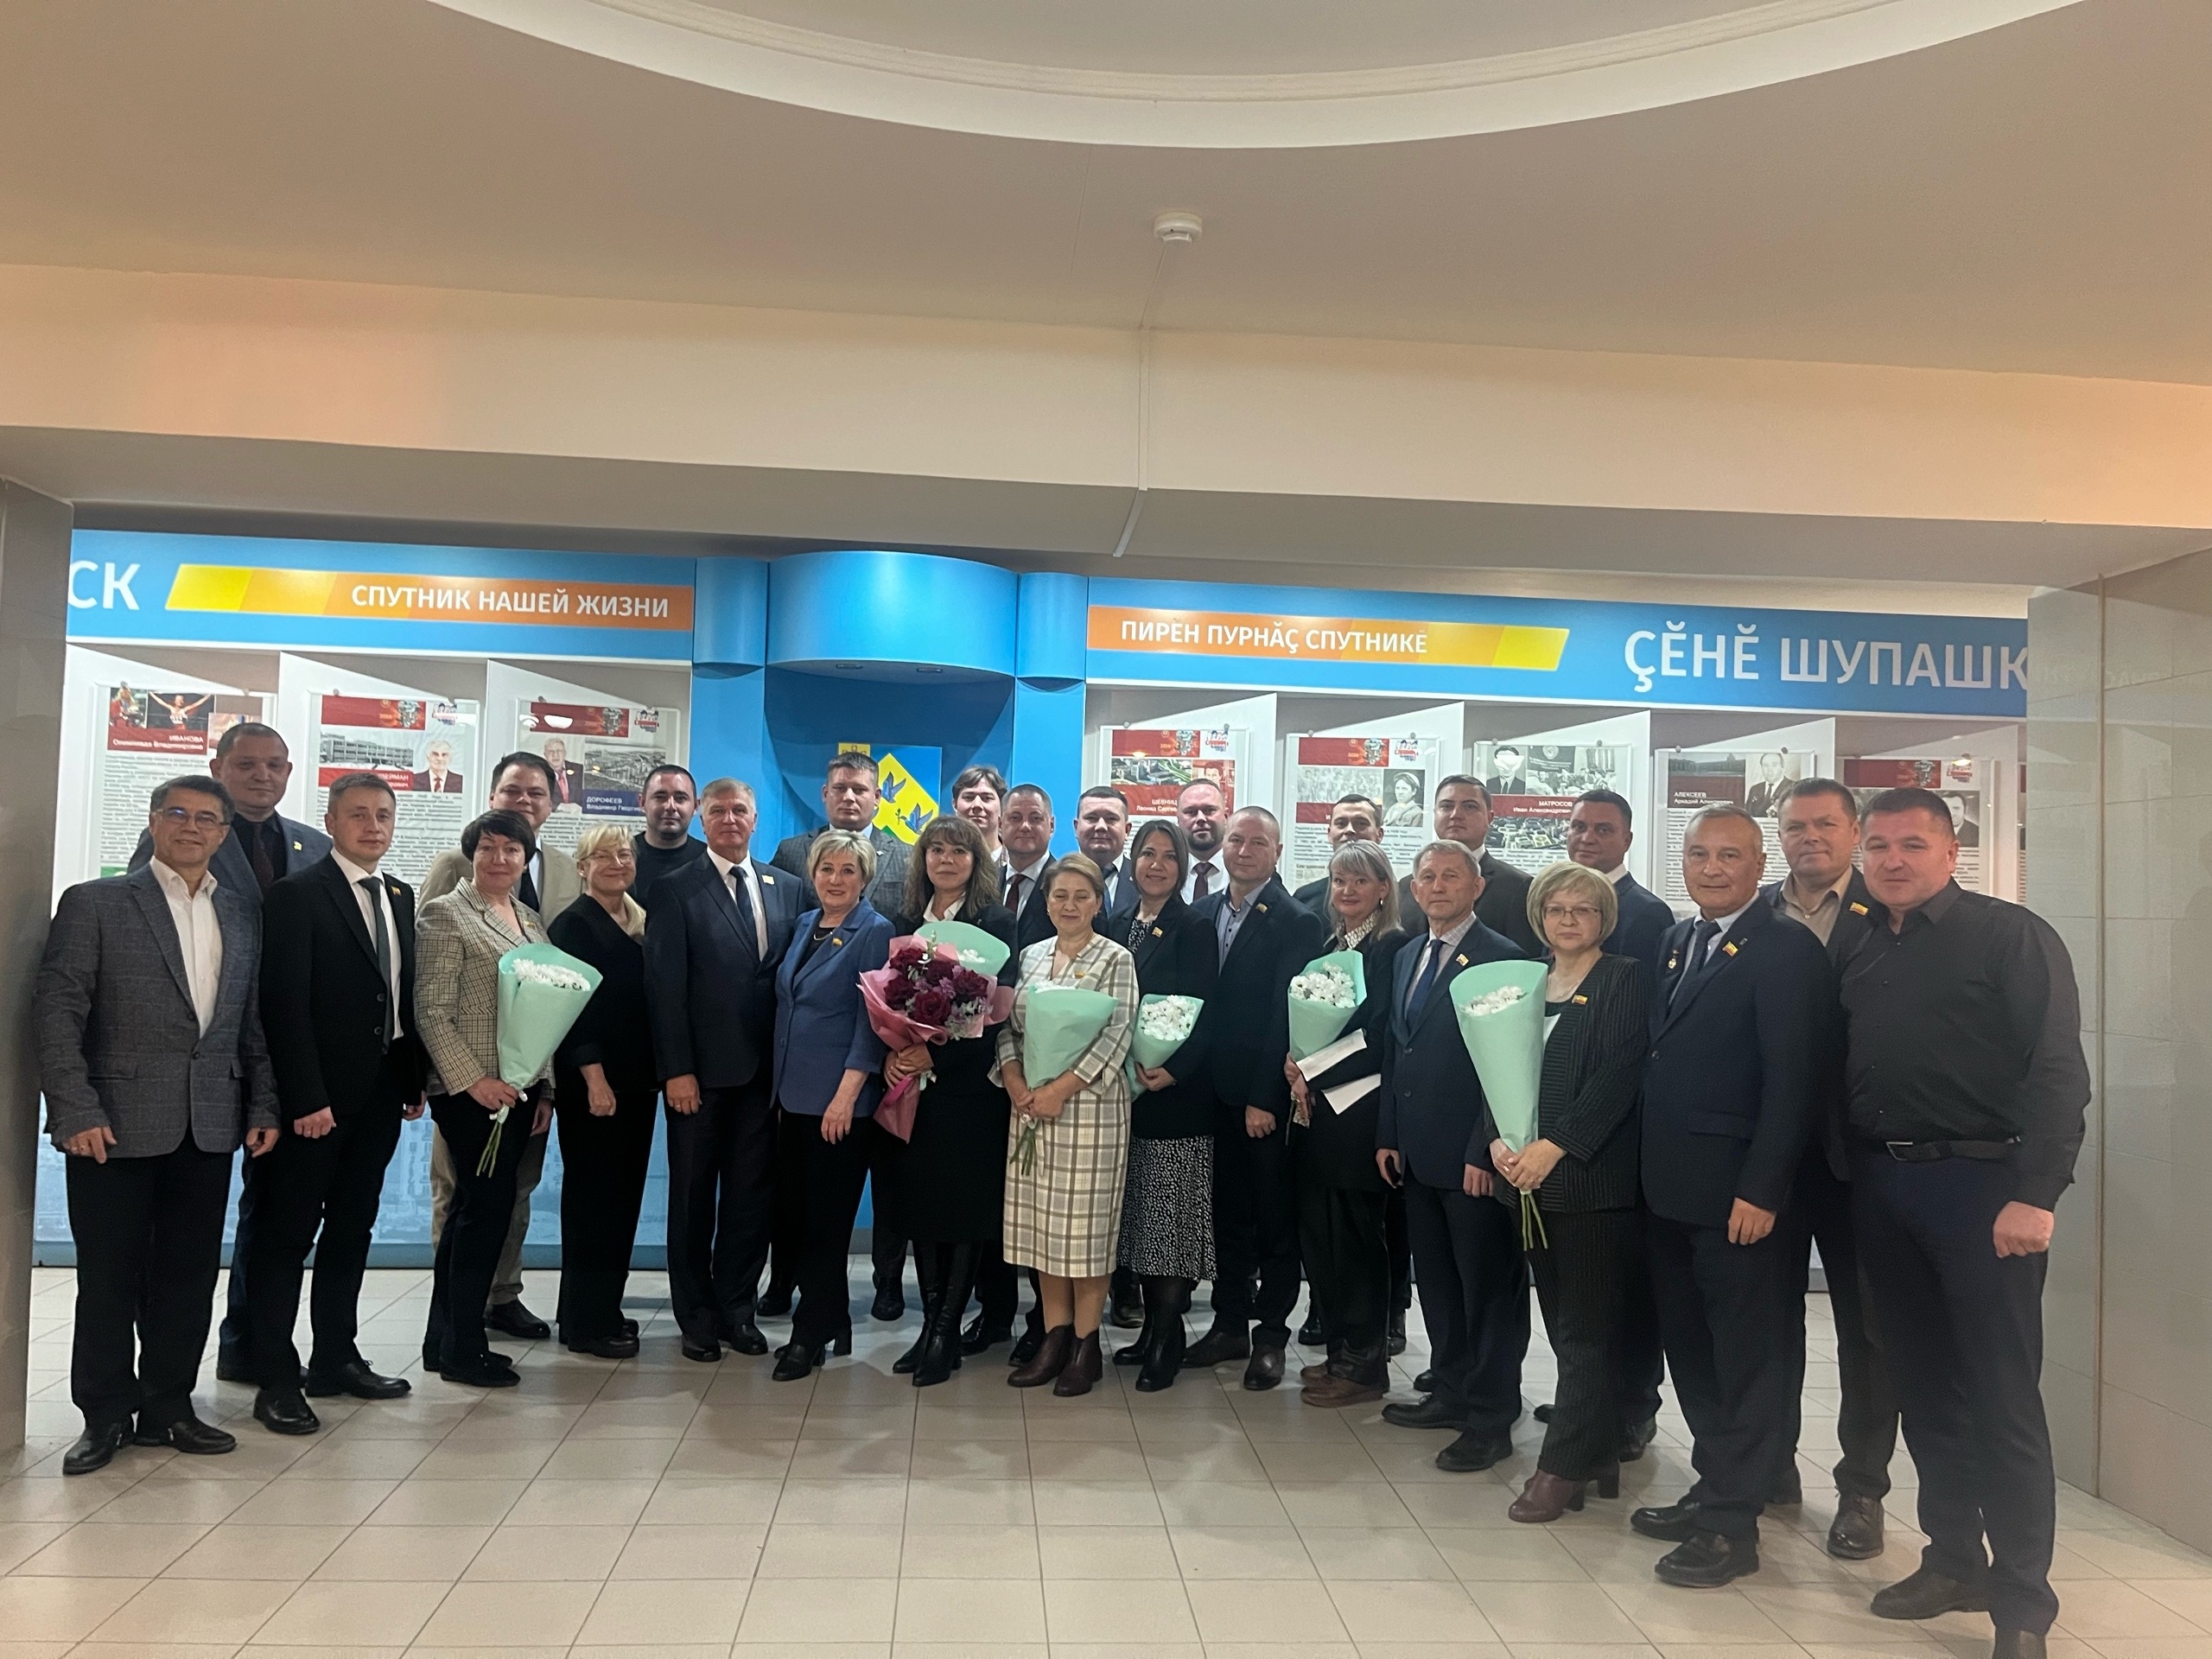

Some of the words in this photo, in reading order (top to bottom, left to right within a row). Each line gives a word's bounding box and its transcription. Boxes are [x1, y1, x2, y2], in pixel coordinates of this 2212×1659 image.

[351, 585, 471, 611] СПУТНИК
[479, 588, 569, 613] НАШЕЙ
[576, 594, 669, 618] ЖИЗНИ
[1780, 638, 2028, 690] ШУПАШК
